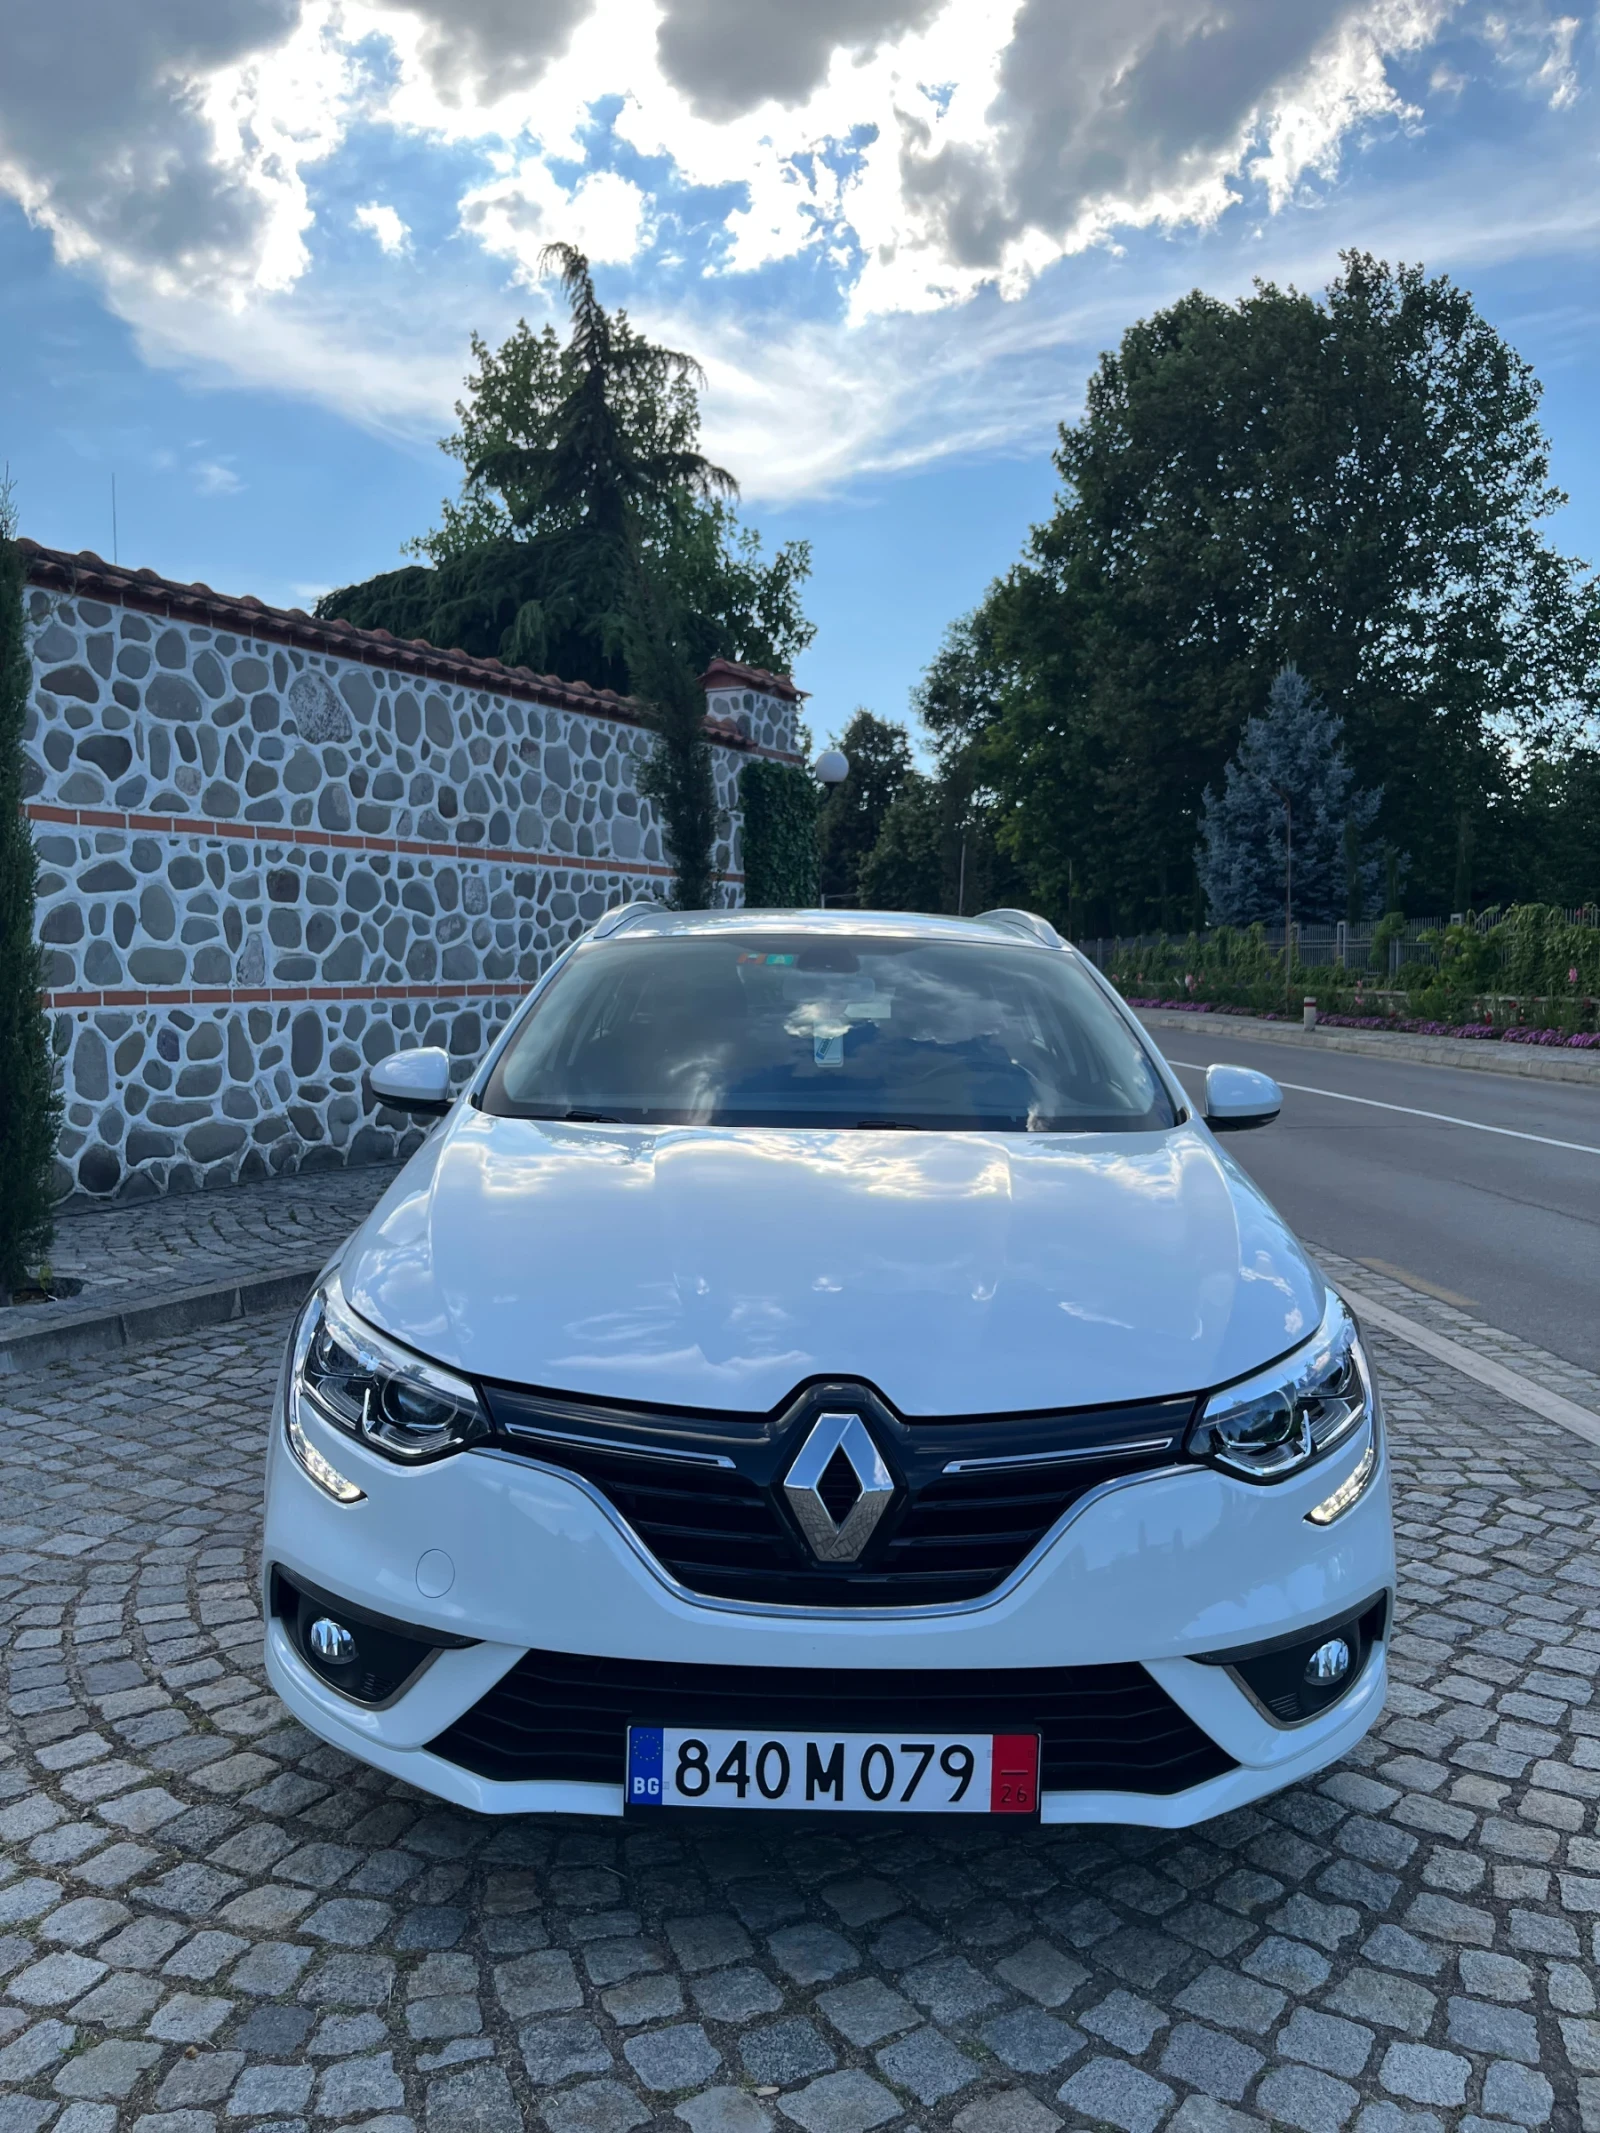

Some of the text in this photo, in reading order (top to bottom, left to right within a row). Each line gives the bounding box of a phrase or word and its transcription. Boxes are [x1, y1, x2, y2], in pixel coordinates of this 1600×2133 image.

[675, 1738, 791, 1799] 840
[860, 1743, 975, 1803] 079
[633, 1776, 660, 1795] BG
[1000, 1783, 1028, 1804] 26
